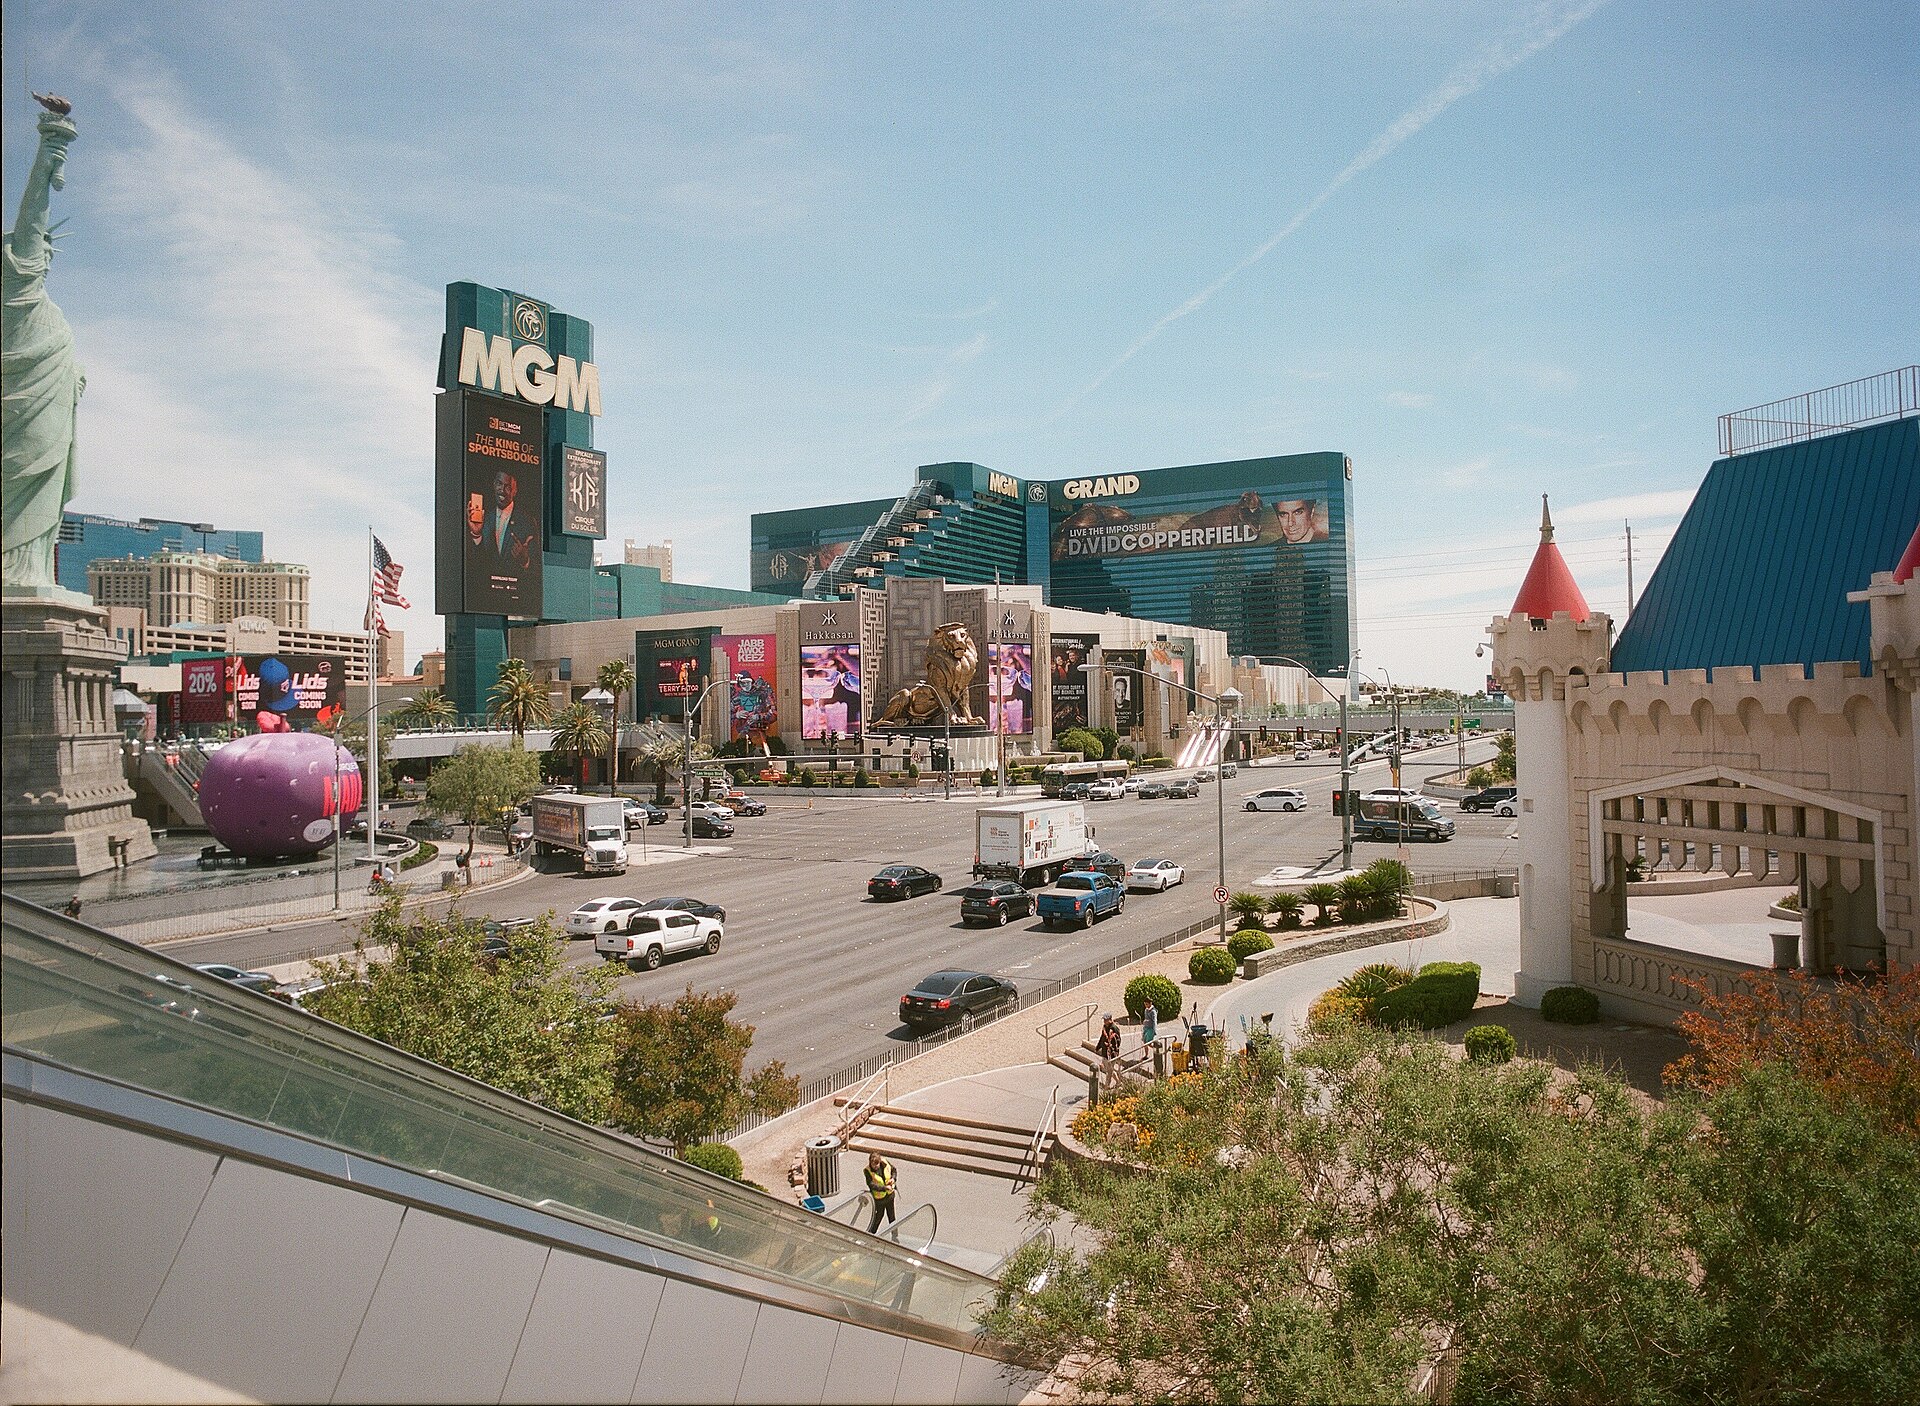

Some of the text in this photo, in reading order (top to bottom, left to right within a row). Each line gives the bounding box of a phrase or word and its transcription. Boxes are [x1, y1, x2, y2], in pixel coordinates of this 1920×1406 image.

[458, 326, 602, 417] MGM
[475, 433, 534, 454] THE KING OF
[468, 442, 540, 465] SPORTSBOOKS
[989, 471, 1140, 500] MGM GRAND
[575, 516, 595, 526] CIRQUE
[1070, 522, 1156, 537] LIVE THE IMPOSSIBLE
[805, 631, 853, 640] Hakkasan
[654, 638, 700, 649] MGM GRAND
[737, 639, 765, 647] JABB
[738, 653, 765, 662] KEEZ
[189, 672, 218, 693] 20%
[237, 674, 261, 689] Lids
[292, 673, 329, 690] Lids
[658, 685, 680, 693] TERRY
[238, 692, 259, 701] COMING
[293, 691, 326, 701] COMING
[241, 701, 257, 710] SOON
[299, 700, 322, 709] SOON
